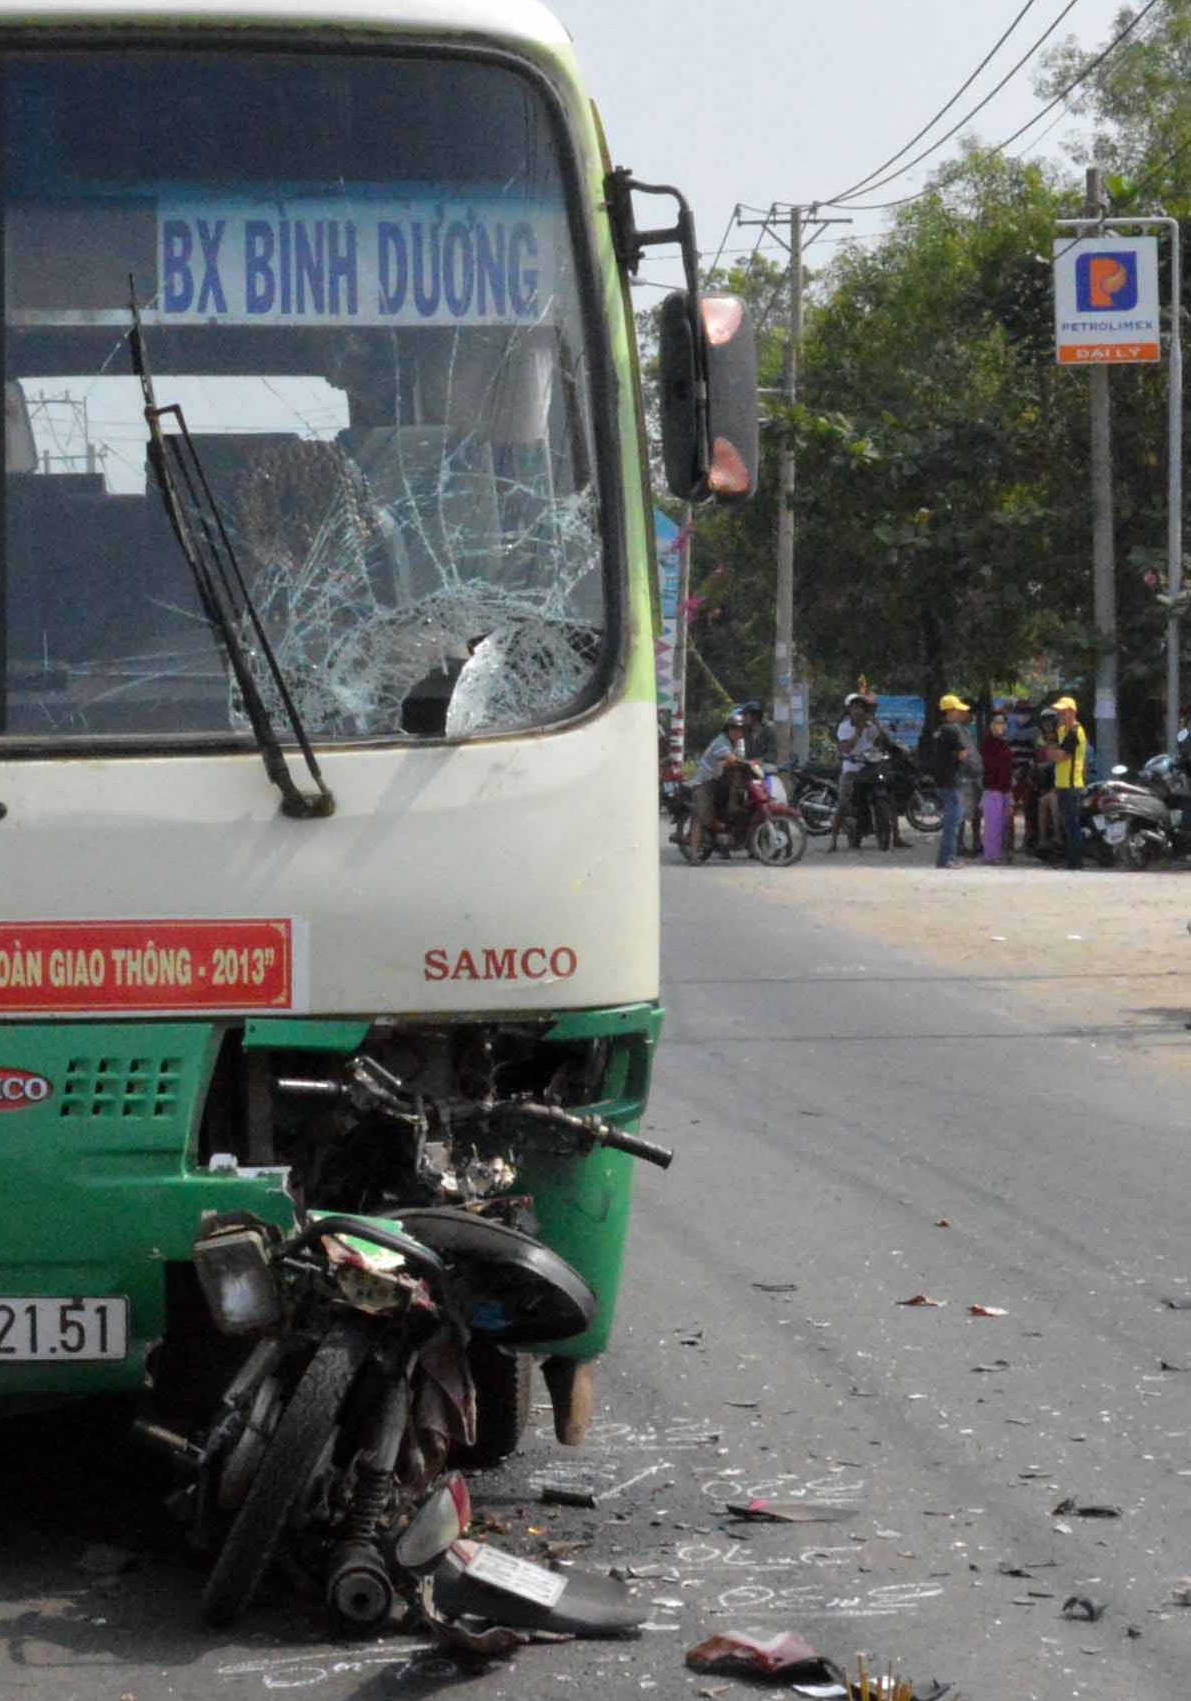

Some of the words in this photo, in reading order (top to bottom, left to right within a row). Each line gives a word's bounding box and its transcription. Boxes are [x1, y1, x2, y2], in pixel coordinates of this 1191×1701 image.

[162, 218, 228, 315] BX
[244, 202, 359, 316] BÌNH
[377, 202, 538, 318] DƯƠNG
[49, 949, 105, 986] GIAO
[112, 940, 191, 986] THÔNG
[424, 946, 578, 981] SAMCO
